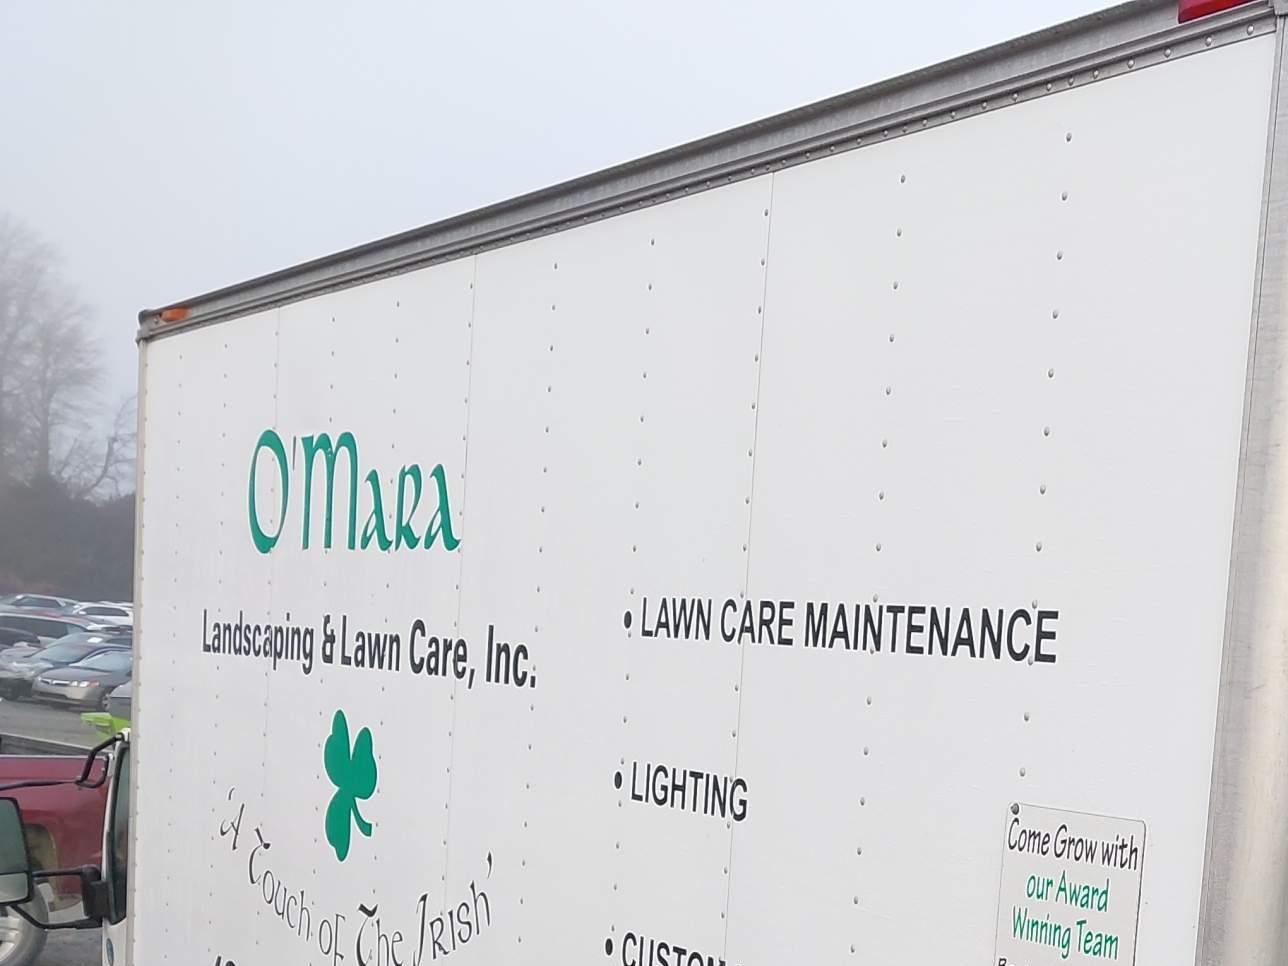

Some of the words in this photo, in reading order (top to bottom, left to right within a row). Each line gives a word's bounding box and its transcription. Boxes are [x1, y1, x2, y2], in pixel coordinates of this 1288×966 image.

[202, 609, 314, 675] Landscaping
[322, 615, 336, 664] &
[340, 615, 401, 672] Lawn
[409, 619, 476, 690] Care,
[486, 625, 536, 688] Inc.
[640, 597, 712, 641] LAWN
[720, 598, 795, 646] CARE
[804, 601, 1060, 663] MAINTENANCE
[630, 761, 748, 822] LIGHTING
[1008, 817, 1051, 858] Come
[1053, 823, 1098, 865] Grow
[1101, 833, 1139, 870] with
[249, 827, 310, 941] Touch
[1026, 873, 1054, 900] our
[1055, 870, 1110, 912] Award
[1012, 906, 1071, 959] Winning
[1076, 920, 1119, 960] Team
